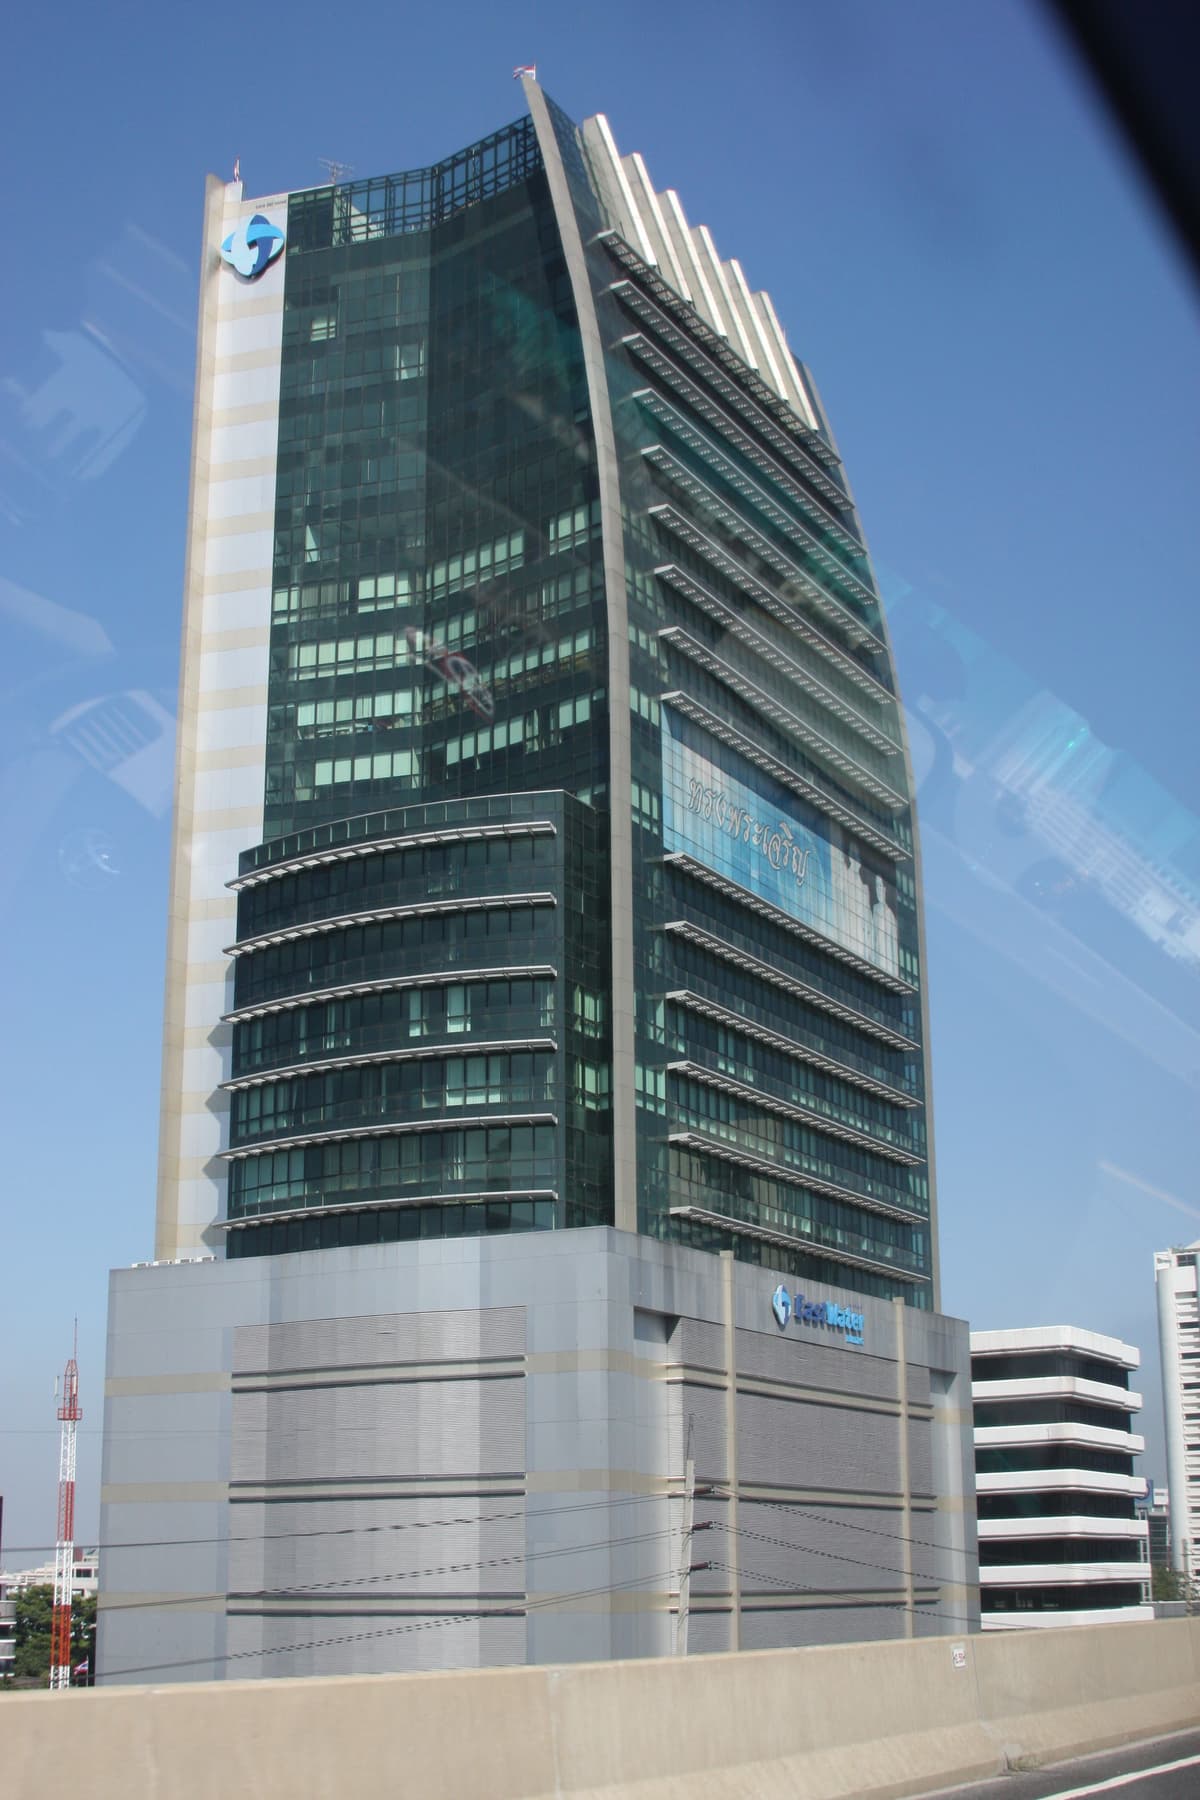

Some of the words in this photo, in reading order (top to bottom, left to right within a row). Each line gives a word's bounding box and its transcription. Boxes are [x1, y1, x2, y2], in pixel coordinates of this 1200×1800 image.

[688, 777, 811, 886] ทรงพระเจริญ
